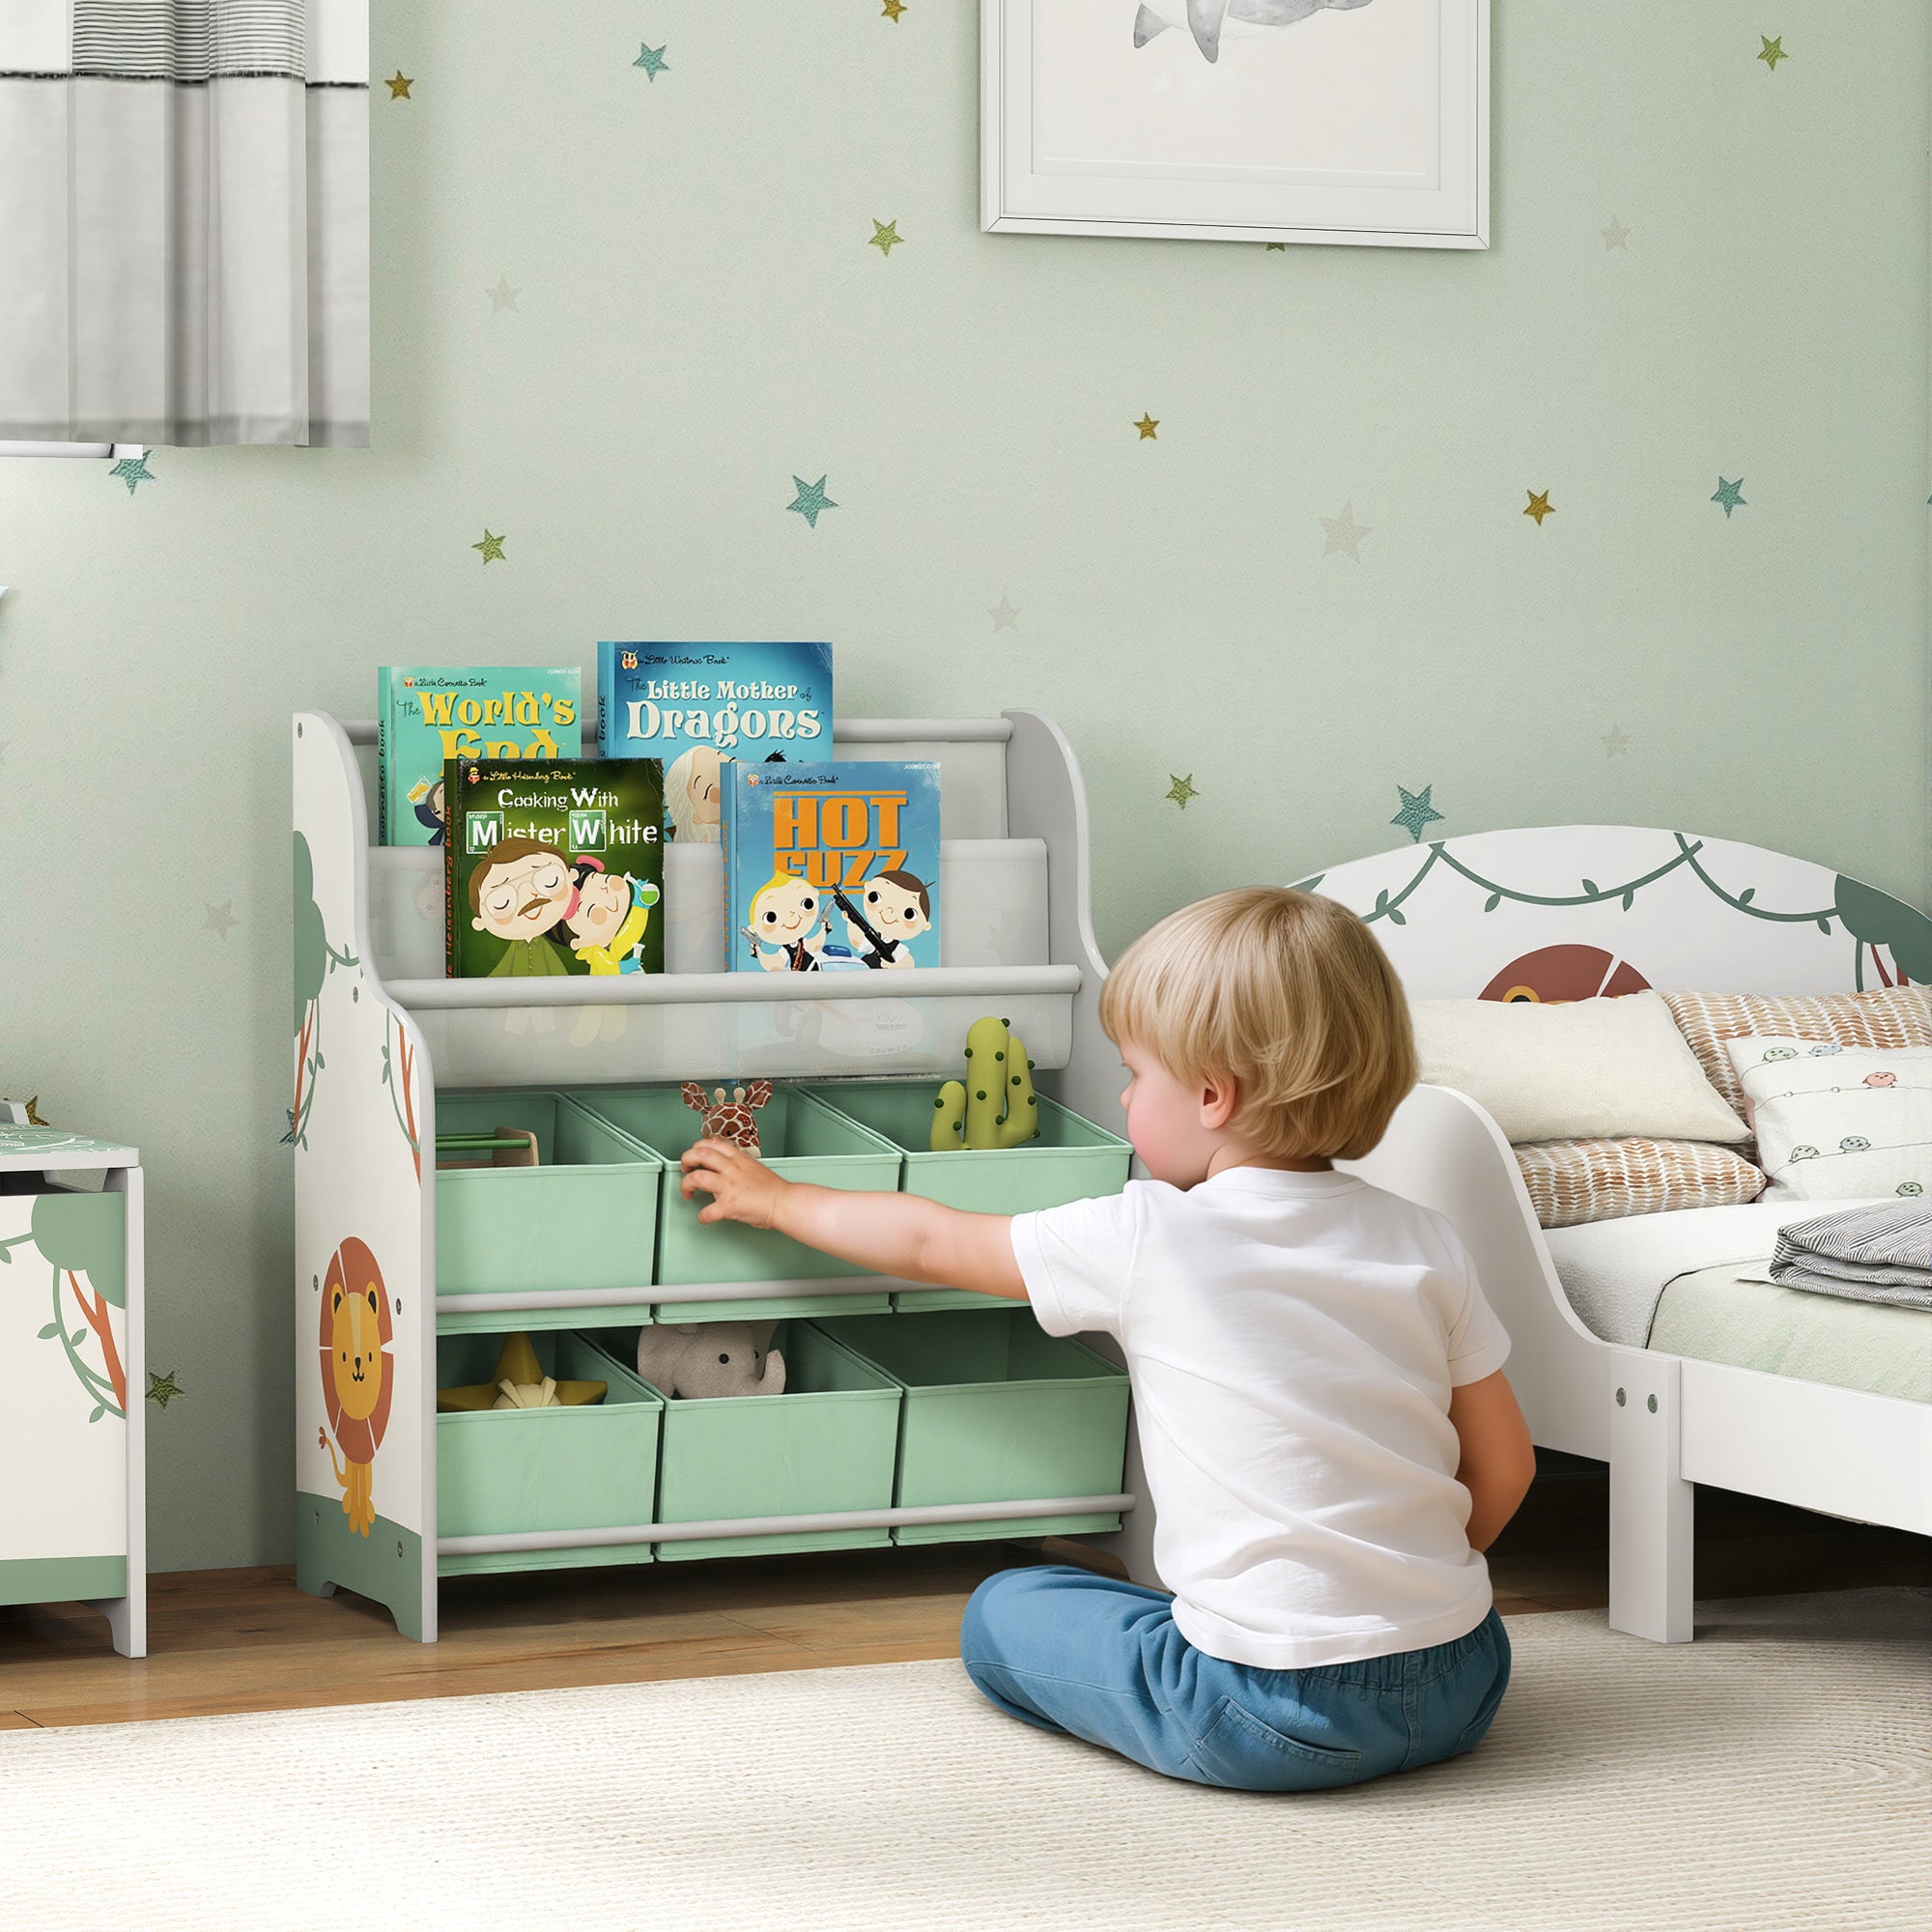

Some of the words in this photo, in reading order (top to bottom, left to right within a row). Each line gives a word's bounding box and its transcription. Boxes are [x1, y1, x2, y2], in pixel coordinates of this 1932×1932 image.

[646, 679, 711, 701] Little
[716, 680, 799, 701] Mother
[396, 699, 421, 717] The
[415, 690, 577, 727] World's
[626, 699, 823, 749] Dragons
[497, 787, 569, 811] Cooking
[570, 787, 619, 809] With
[572, 817, 659, 845] White
[774, 797, 909, 850] HOT
